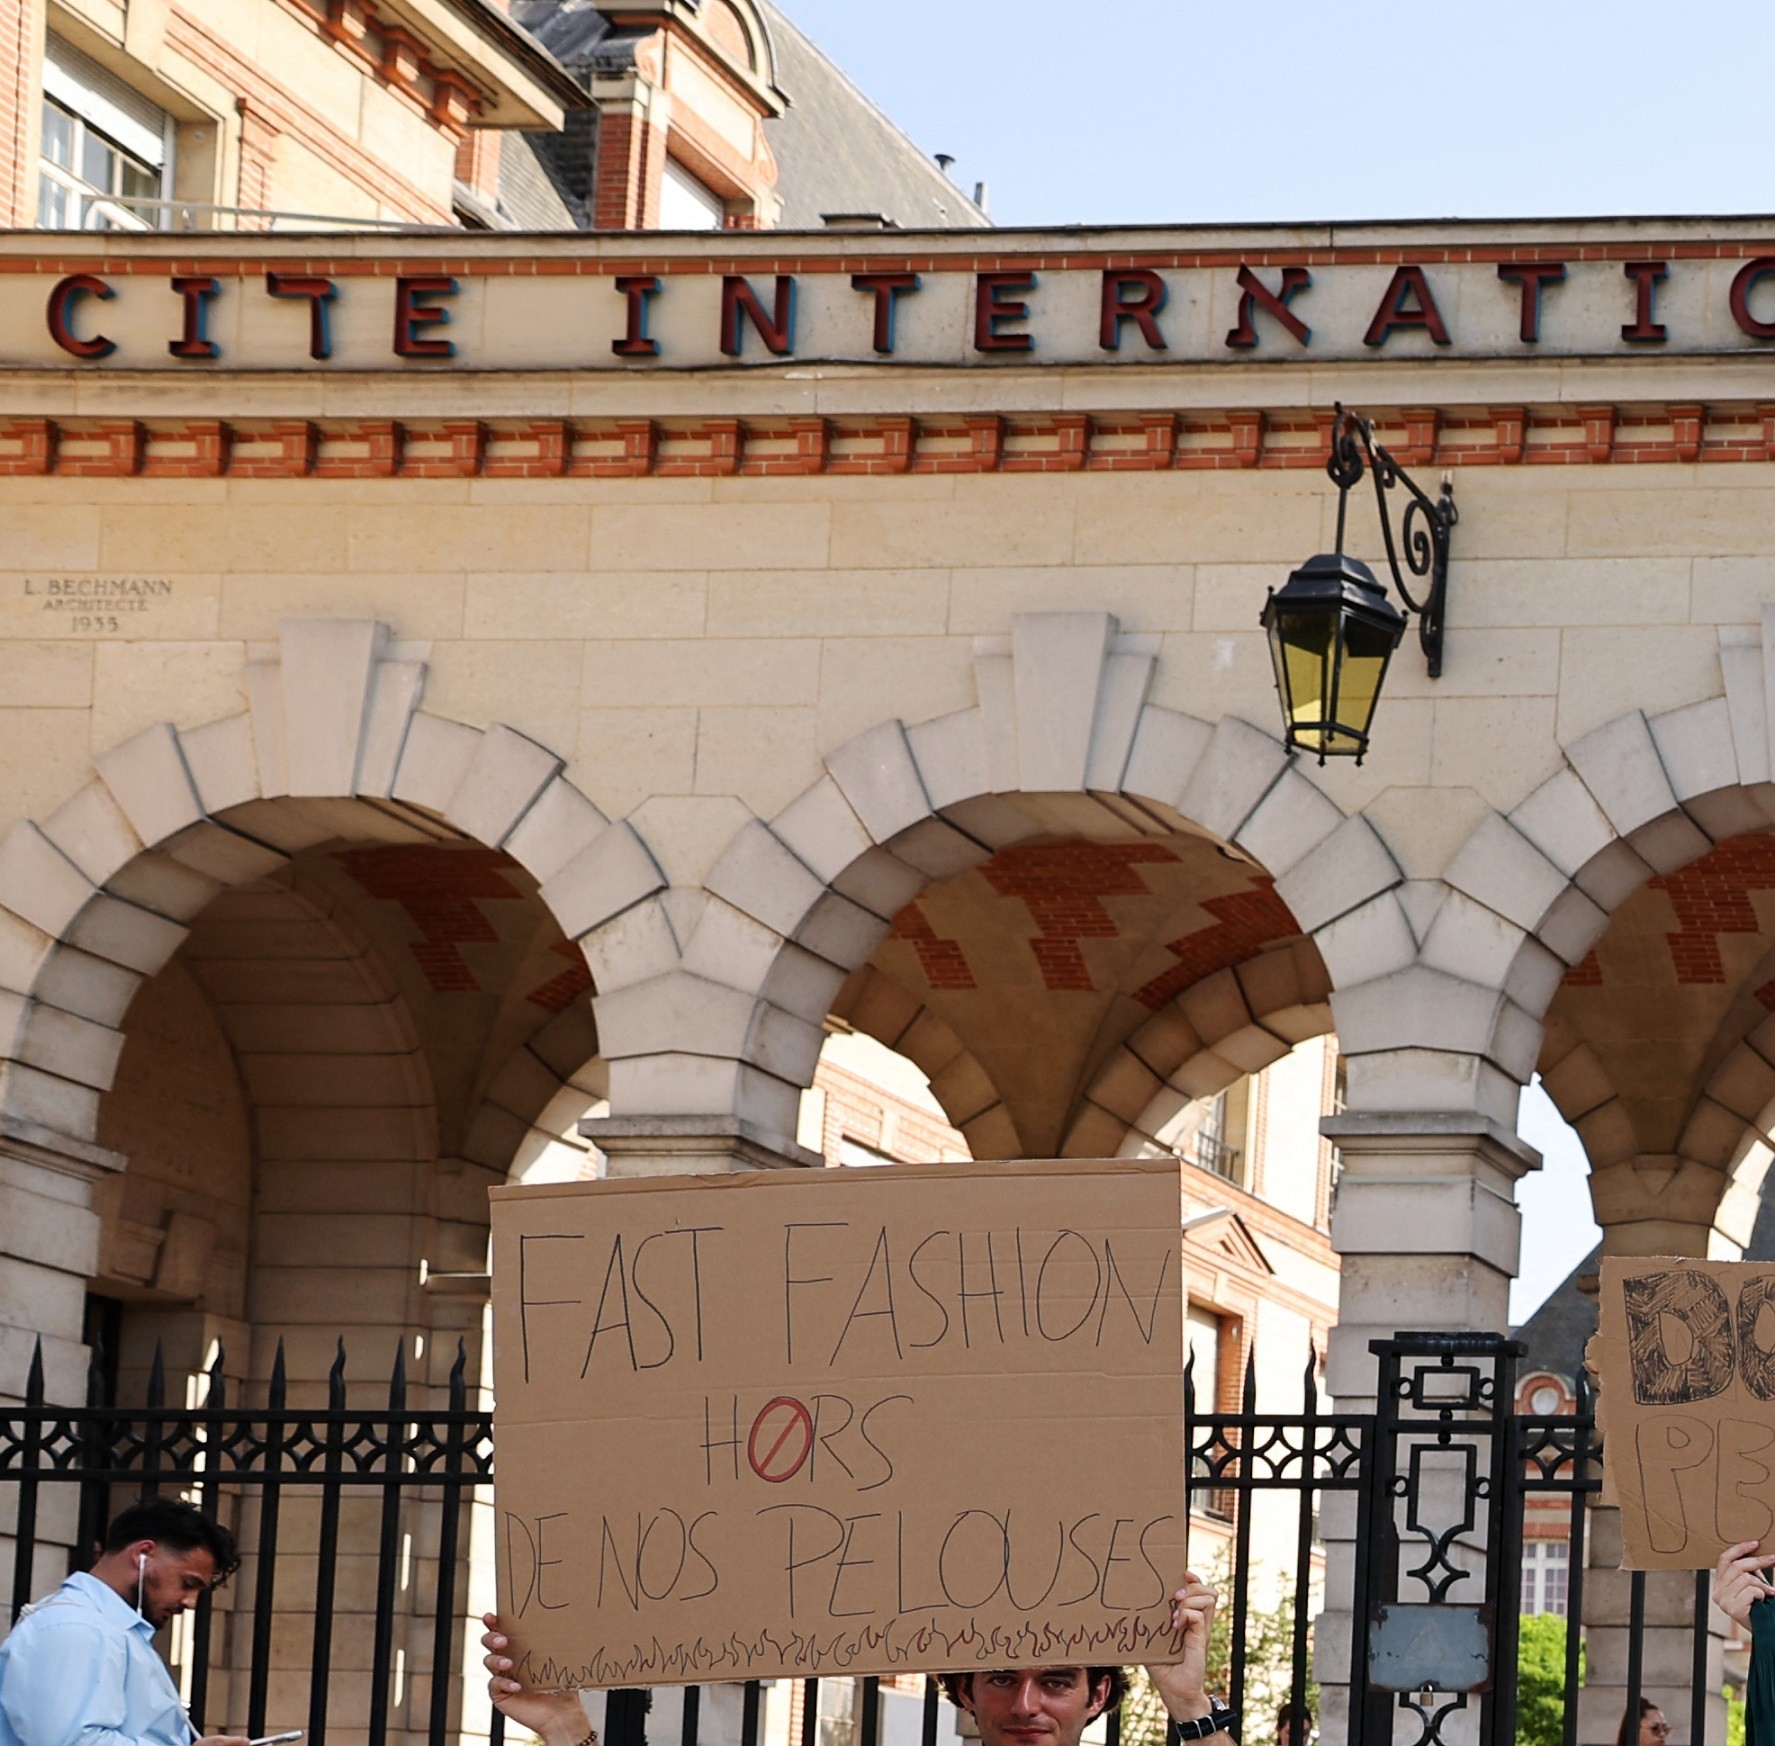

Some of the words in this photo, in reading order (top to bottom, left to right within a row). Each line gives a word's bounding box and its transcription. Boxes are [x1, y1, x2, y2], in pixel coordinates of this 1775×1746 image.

[24, 579, 42, 596] L.
[48, 579, 173, 596] BECHMANN
[42, 599, 149, 612] ARCHITECTE
[519, 1226, 724, 1384] FAST
[784, 1222, 1172, 1367] FASHION
[505, 1511, 570, 1619] DE
[597, 1506, 719, 1612] NOS
[755, 1503, 1173, 1619] PELOUSES
